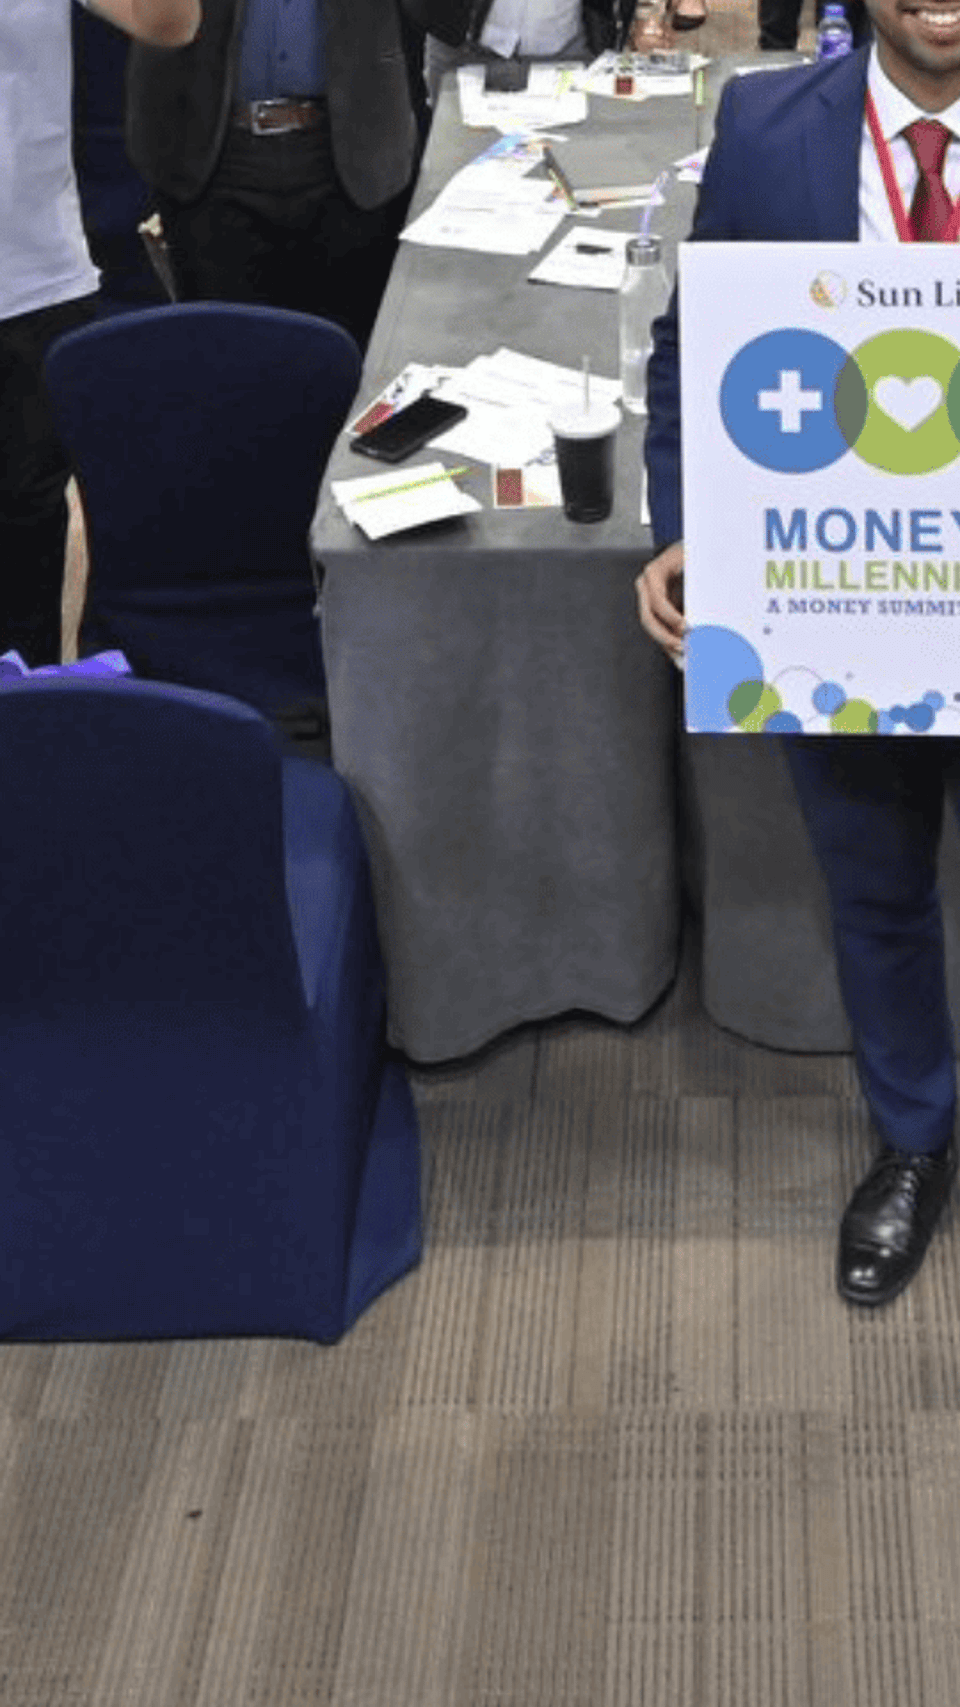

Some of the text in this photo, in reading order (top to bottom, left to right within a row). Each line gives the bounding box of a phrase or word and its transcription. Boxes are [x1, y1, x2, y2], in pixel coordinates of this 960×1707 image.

[857, 278, 922, 308] Sun
[766, 599, 781, 614] A
[787, 599, 871, 615] MONEY
